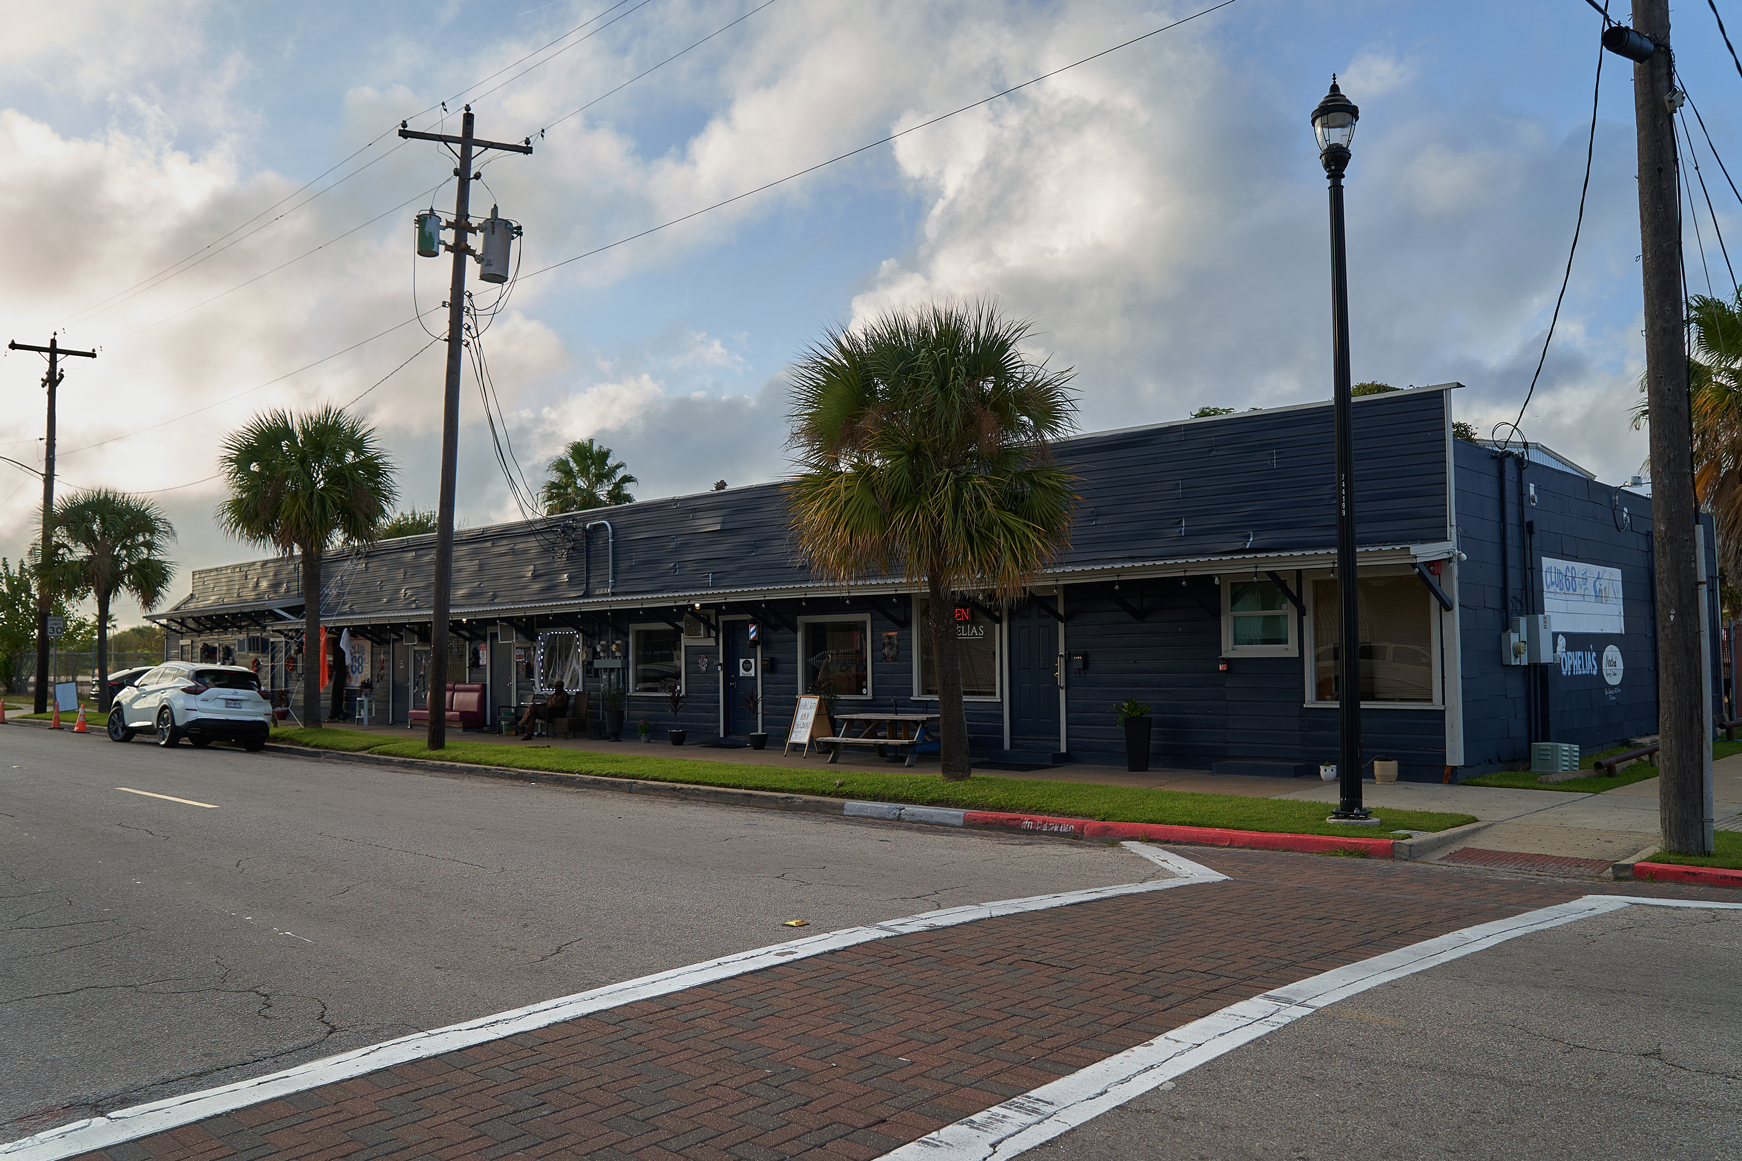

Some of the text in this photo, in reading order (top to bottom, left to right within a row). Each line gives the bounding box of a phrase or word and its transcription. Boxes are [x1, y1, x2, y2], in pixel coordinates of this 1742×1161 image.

[1545, 565, 1577, 592] CLUB 68
[954, 608, 969, 621] EN
[48, 626, 63, 634] 30
[351, 655, 364, 675] 68
[1021, 820, 1075, 833] NO PARKING
